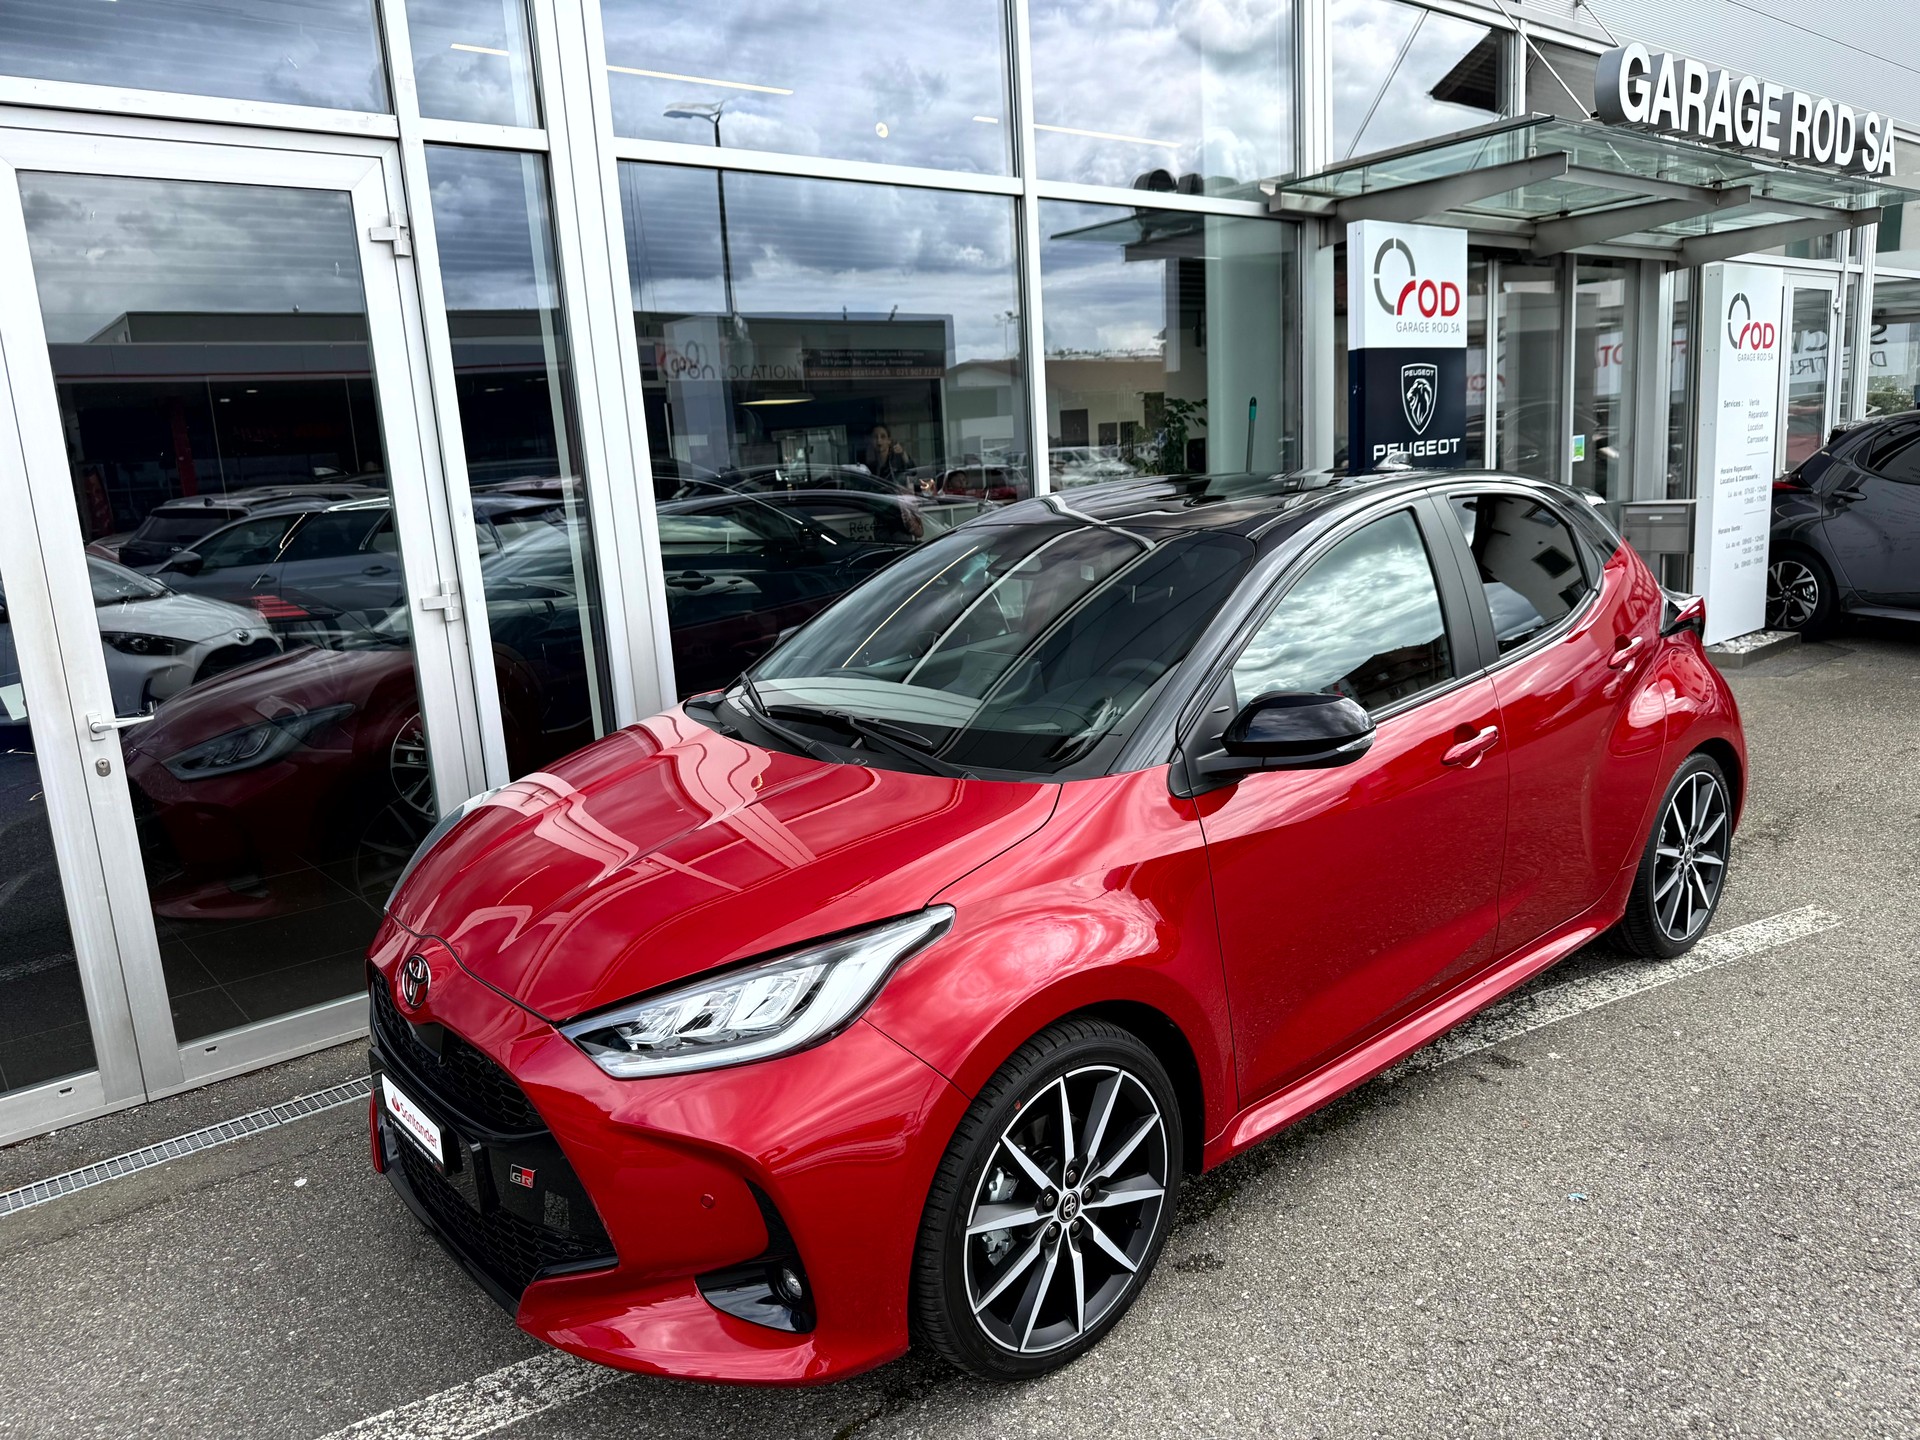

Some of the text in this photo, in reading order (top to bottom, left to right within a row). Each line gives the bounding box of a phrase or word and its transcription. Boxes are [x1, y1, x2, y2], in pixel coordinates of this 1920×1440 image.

[1619, 43, 1897, 176] GARAGE ROD SA
[1396, 321, 1461, 333] GARAGE ROD SA
[1737, 352, 1774, 362] GARAGE ROD SA
[1404, 368, 1435, 377] PEUGEOT
[1723, 400, 1741, 408] Services
[1373, 438, 1461, 460] PEUGEOT
[399, 1102, 438, 1149] Santander
[511, 1170, 533, 1187] GR
